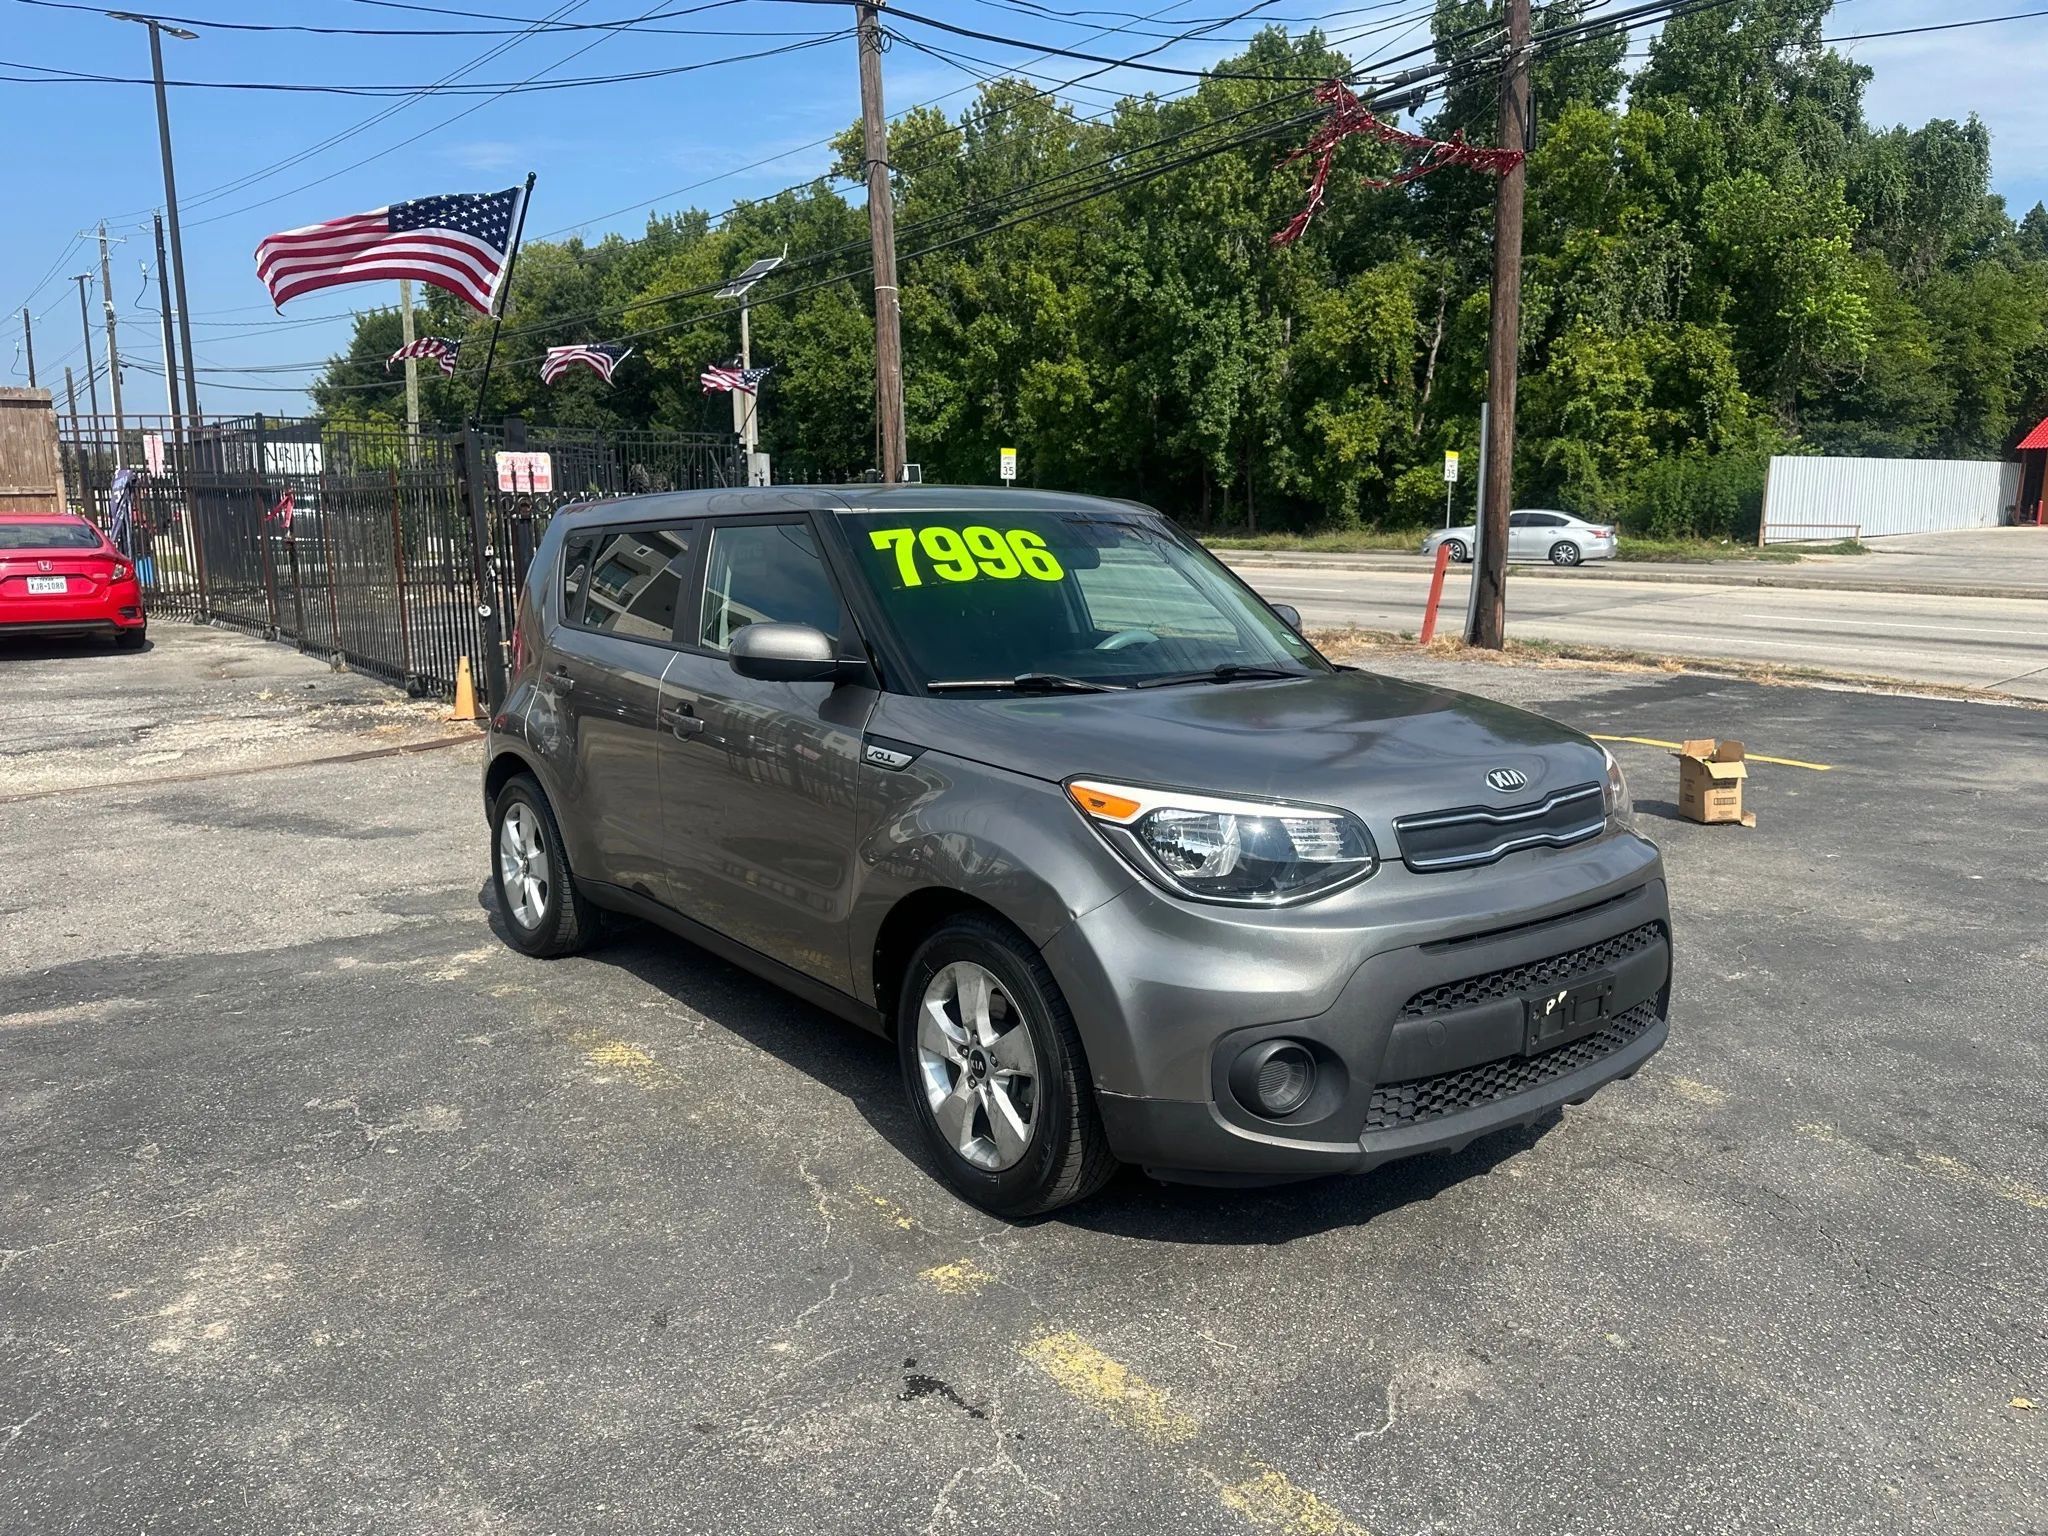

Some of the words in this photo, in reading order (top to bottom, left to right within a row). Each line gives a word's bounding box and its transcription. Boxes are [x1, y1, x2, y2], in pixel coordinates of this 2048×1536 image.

[1003, 466, 1015, 475] 35
[868, 526, 1065, 587] 7996
[1490, 769, 1524, 787] KIA
[970, 1059, 985, 1071] KIA
